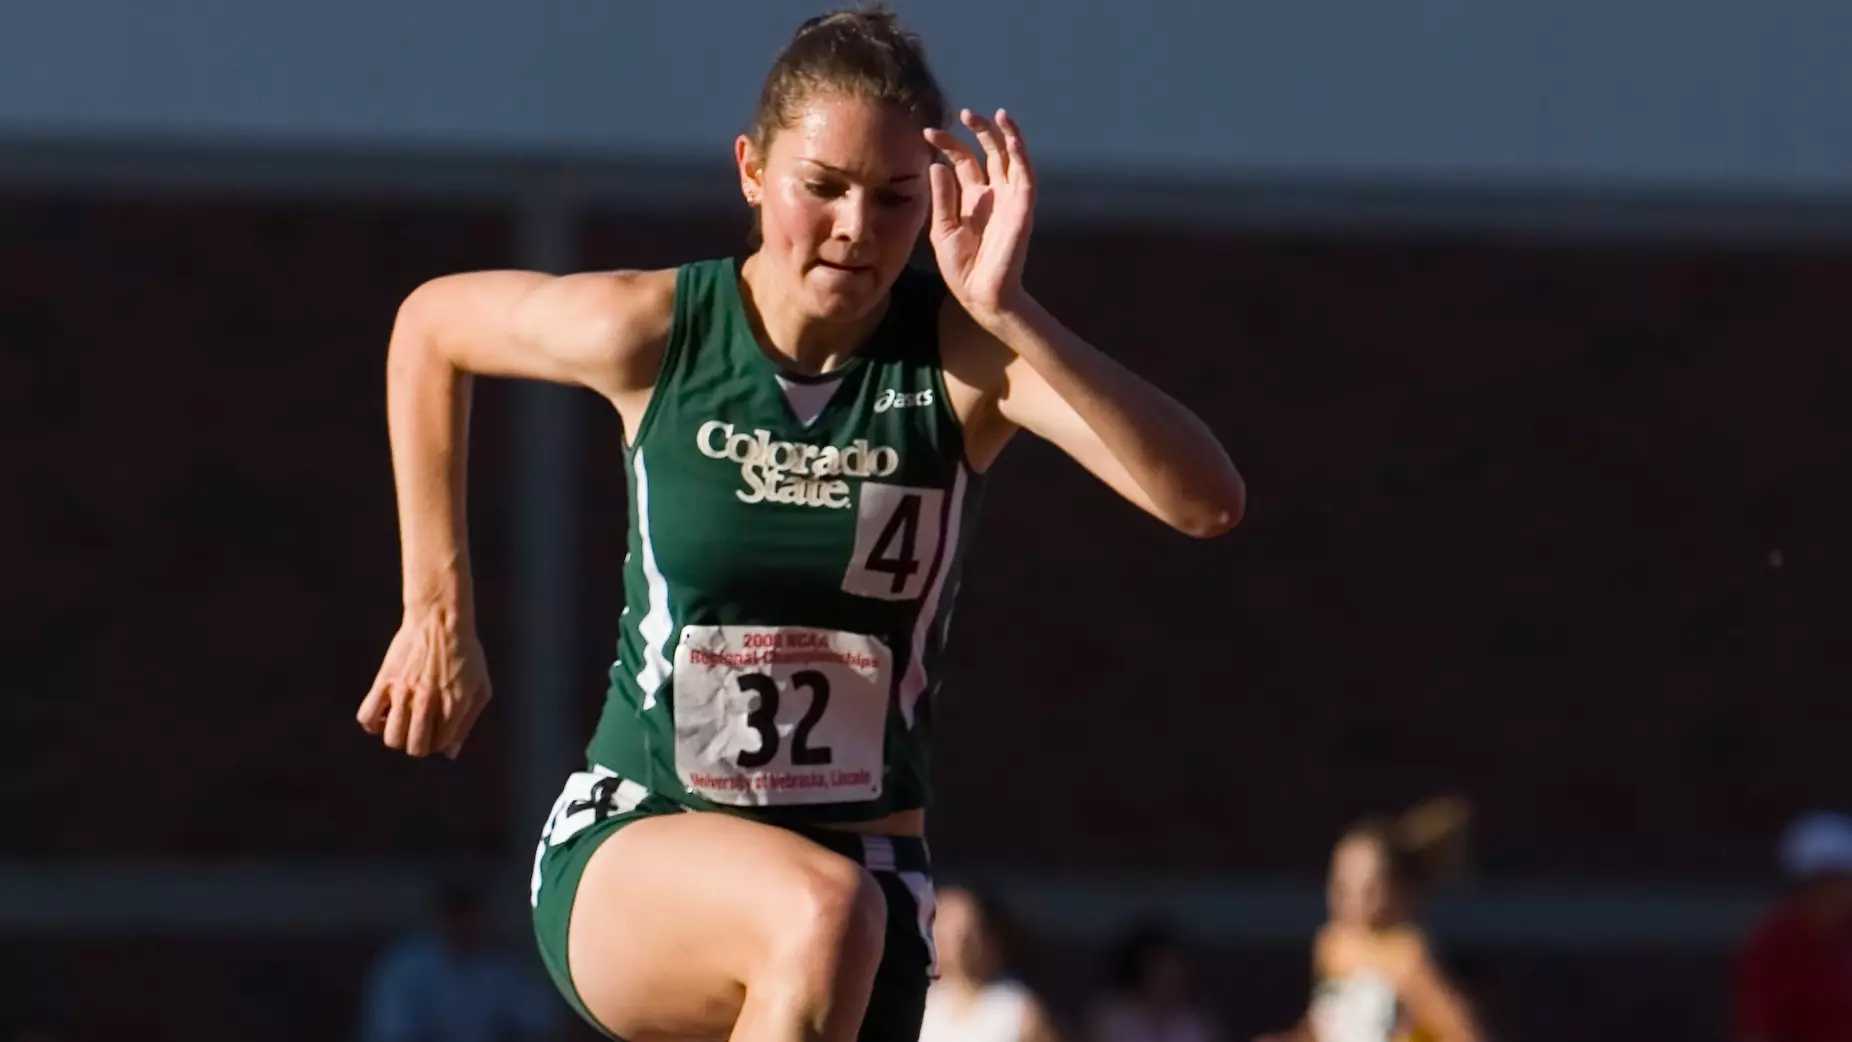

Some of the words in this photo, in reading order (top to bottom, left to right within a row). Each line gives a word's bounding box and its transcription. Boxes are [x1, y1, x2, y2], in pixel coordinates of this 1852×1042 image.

[696, 420, 899, 478] Colorado
[864, 493, 922, 594] 4
[689, 648, 759, 668] Regional
[736, 669, 833, 769] 32
[689, 772, 750, 794] University
[755, 773, 767, 790] of
[830, 768, 871, 787] Lincoln
